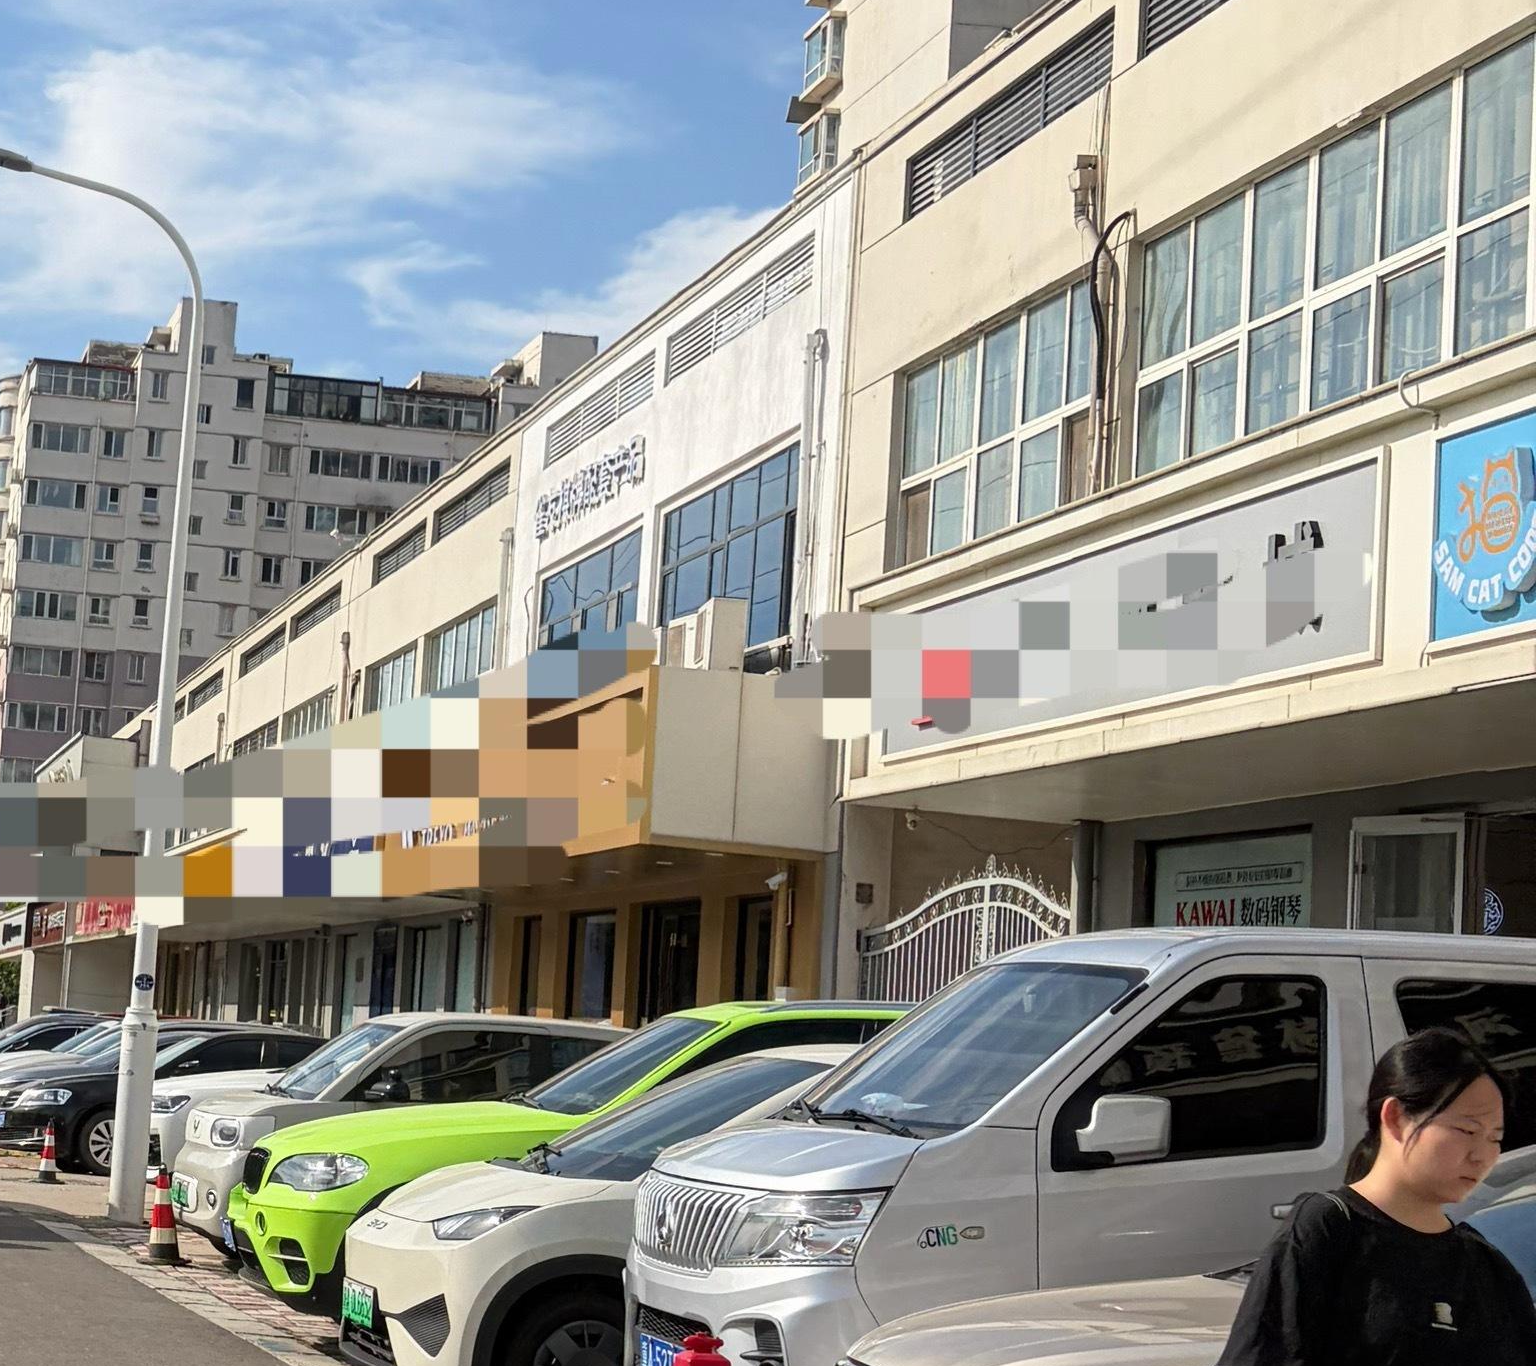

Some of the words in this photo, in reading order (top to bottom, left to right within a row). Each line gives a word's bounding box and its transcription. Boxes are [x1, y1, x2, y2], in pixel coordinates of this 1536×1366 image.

[1434, 540, 1465, 596] SAM
[1467, 573, 1503, 604] CAT
[1176, 898, 1235, 927] KAWAI
[1240, 895, 1302, 927] 数码钢琴
[925, 1226, 958, 1247] CNG
